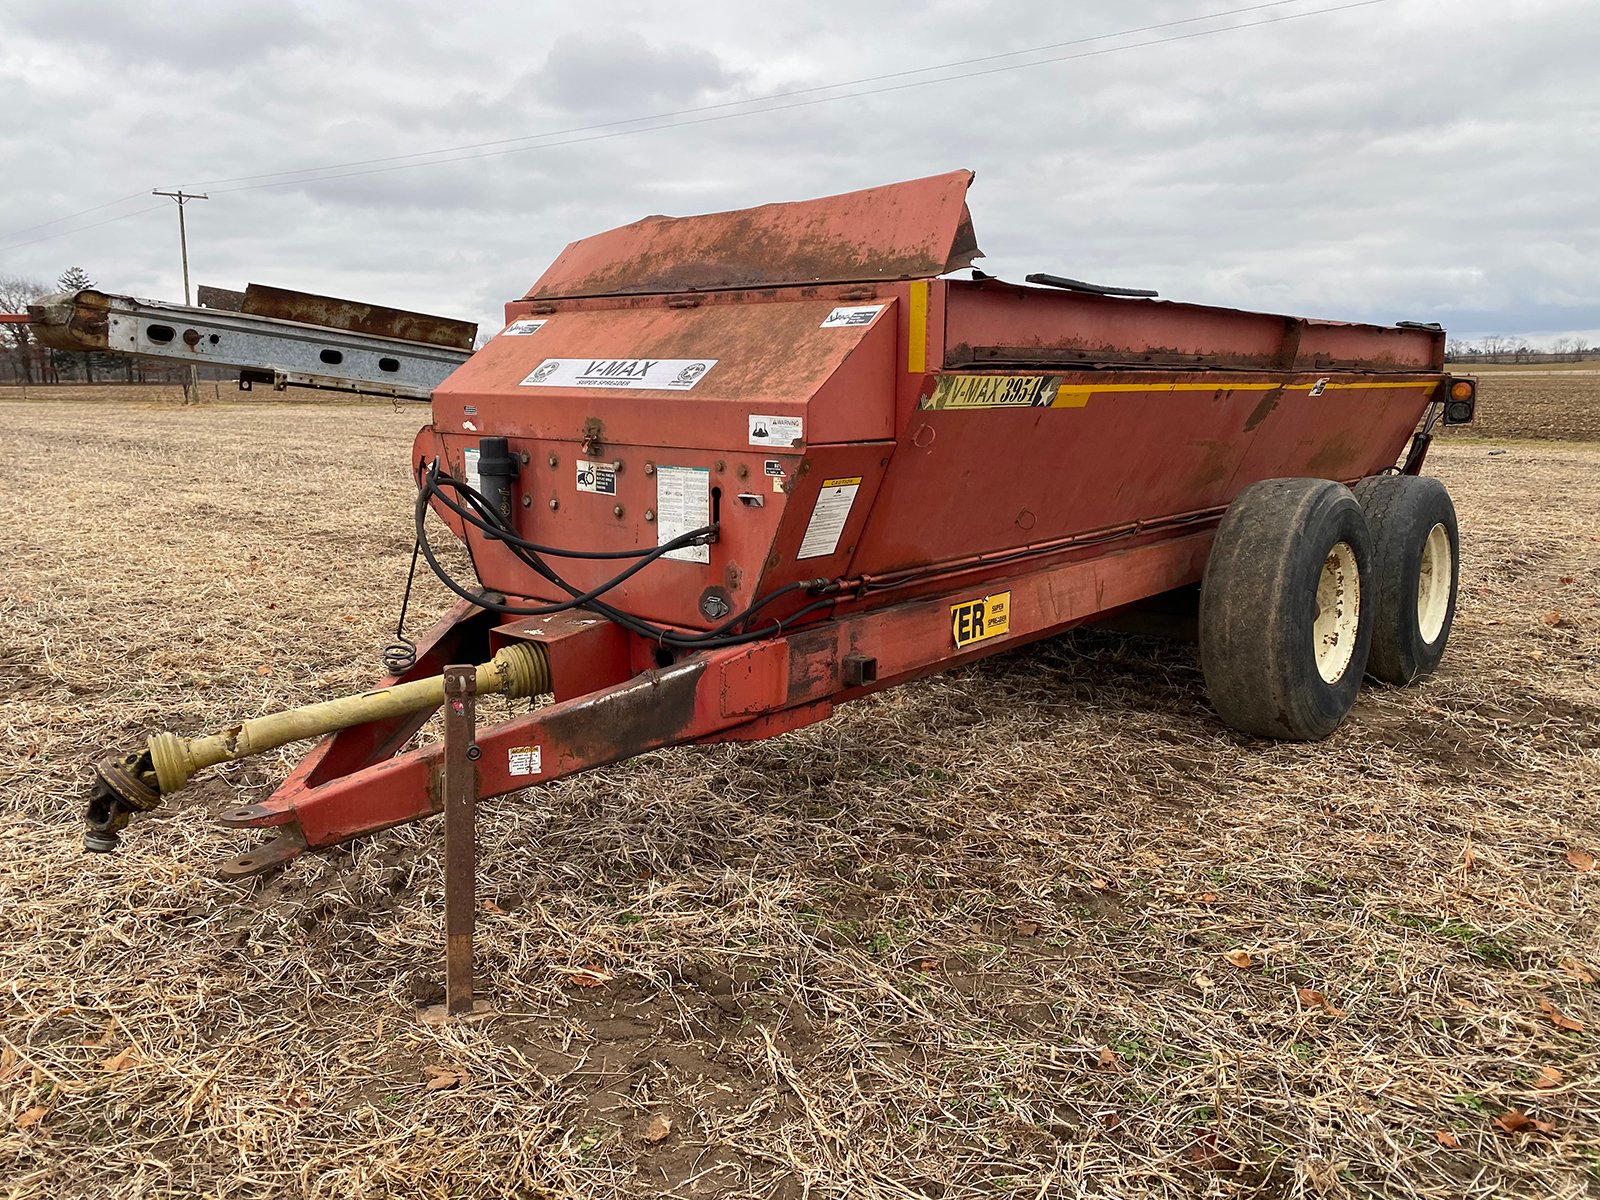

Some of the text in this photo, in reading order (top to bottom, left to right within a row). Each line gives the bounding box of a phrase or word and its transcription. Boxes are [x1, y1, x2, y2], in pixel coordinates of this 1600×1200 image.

[584, 361, 658, 377] V-MAX
[951, 378, 1041, 403] V-MAX 3954
[991, 603, 1004, 612] SUPER
